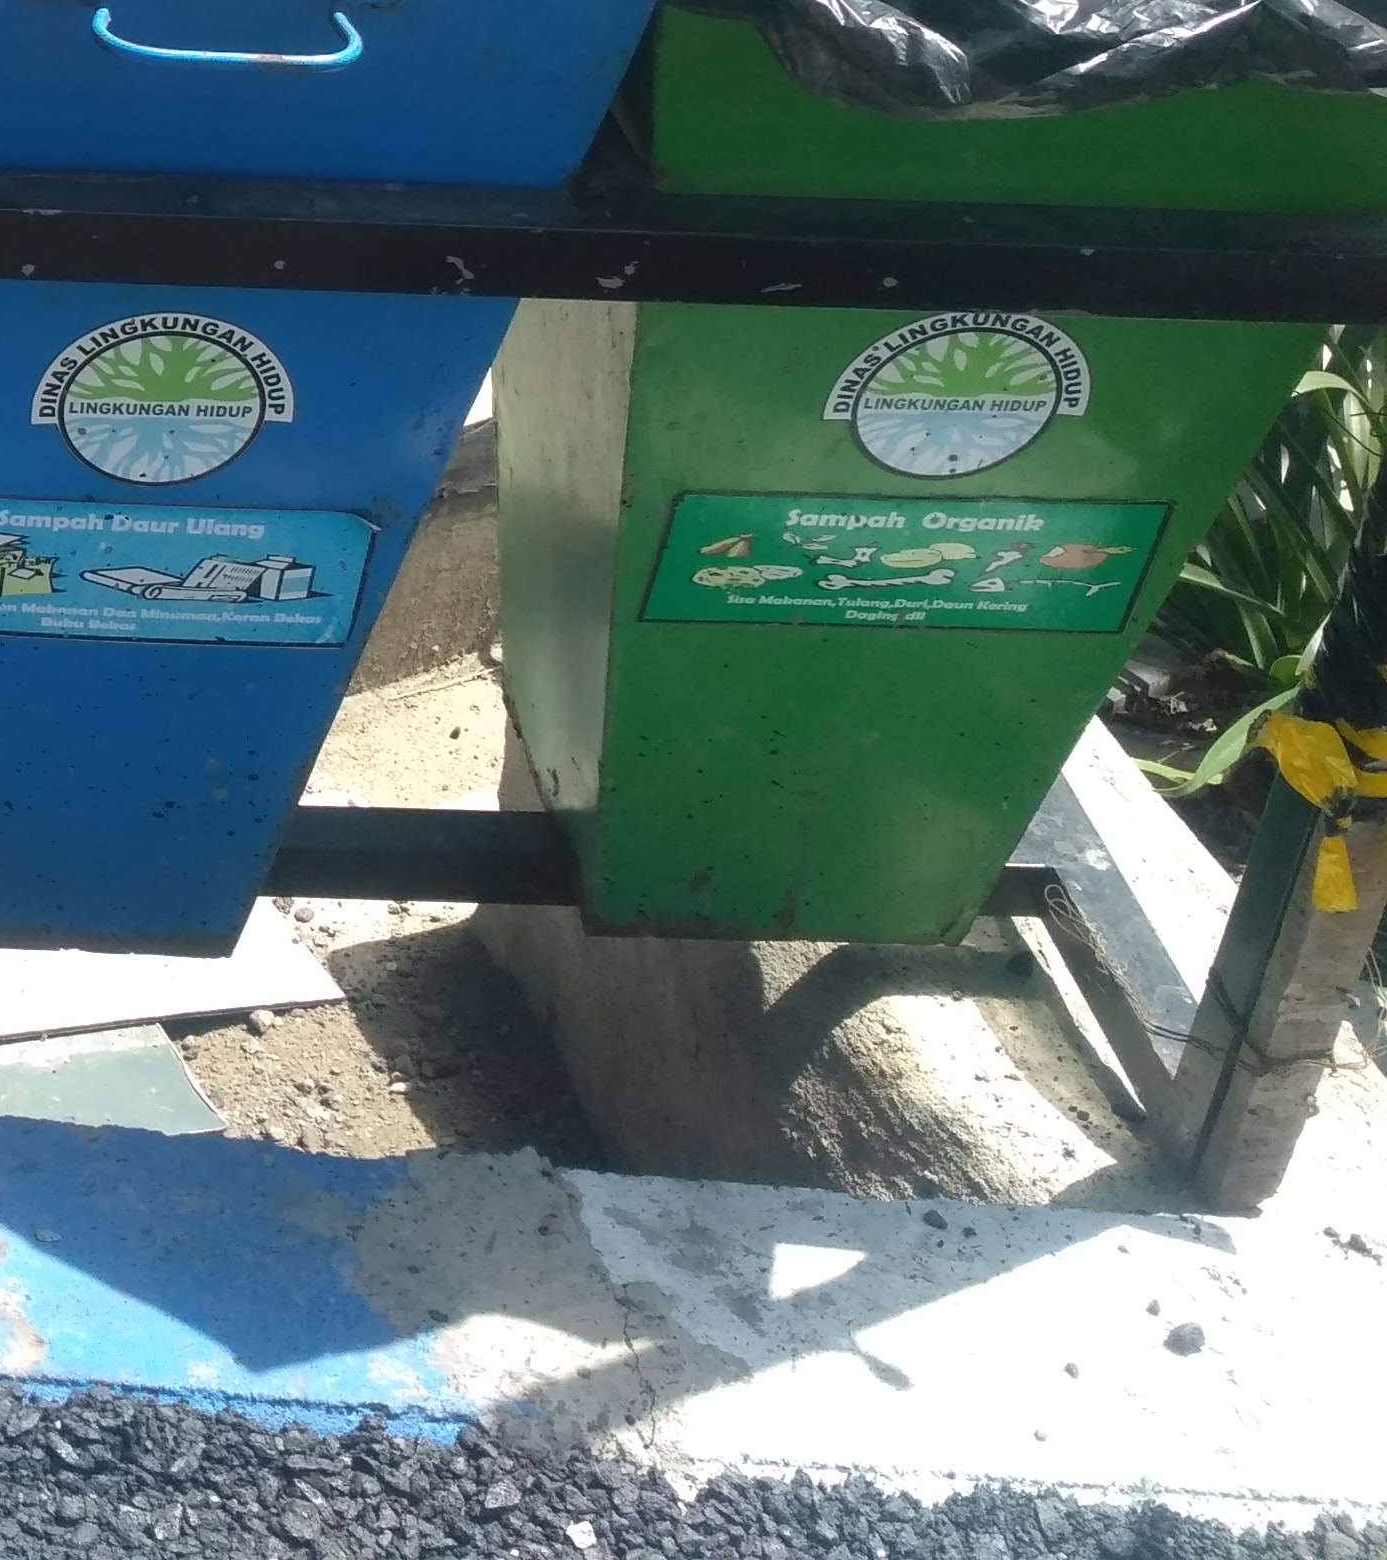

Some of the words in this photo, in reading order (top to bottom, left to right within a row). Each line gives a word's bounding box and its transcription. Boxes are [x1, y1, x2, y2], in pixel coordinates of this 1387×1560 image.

[39, 356, 77, 418] DINAS
[76, 316, 255, 357] LINGKUNGAN
[251, 350, 286, 416] HIDUP
[833, 351, 882, 414] DINAS
[882, 313, 1061, 354] LINGKUNGAN
[1055, 347, 1082, 408] HIDUP
[68, 401, 192, 417] LINGKUNGAN
[196, 403, 253, 418] HIDUP
[863, 396, 985, 413] LINGKUNGAN
[990, 398, 1047, 414] HIDUP
[112, 513, 180, 535] Daur
[185, 517, 265, 540] Ulang
[786, 508, 906, 531] Sampah
[922, 511, 1044, 534] Organik
[21, 602, 98, 616] Makanan
[103, 607, 136, 618] Dan
[274, 613, 322, 624] Bekas
[727, 594, 756, 605] Sisa
[977, 600, 1027, 612] Kering
[41, 616, 84, 628] Buku
[89, 619, 136, 631] Bekas
